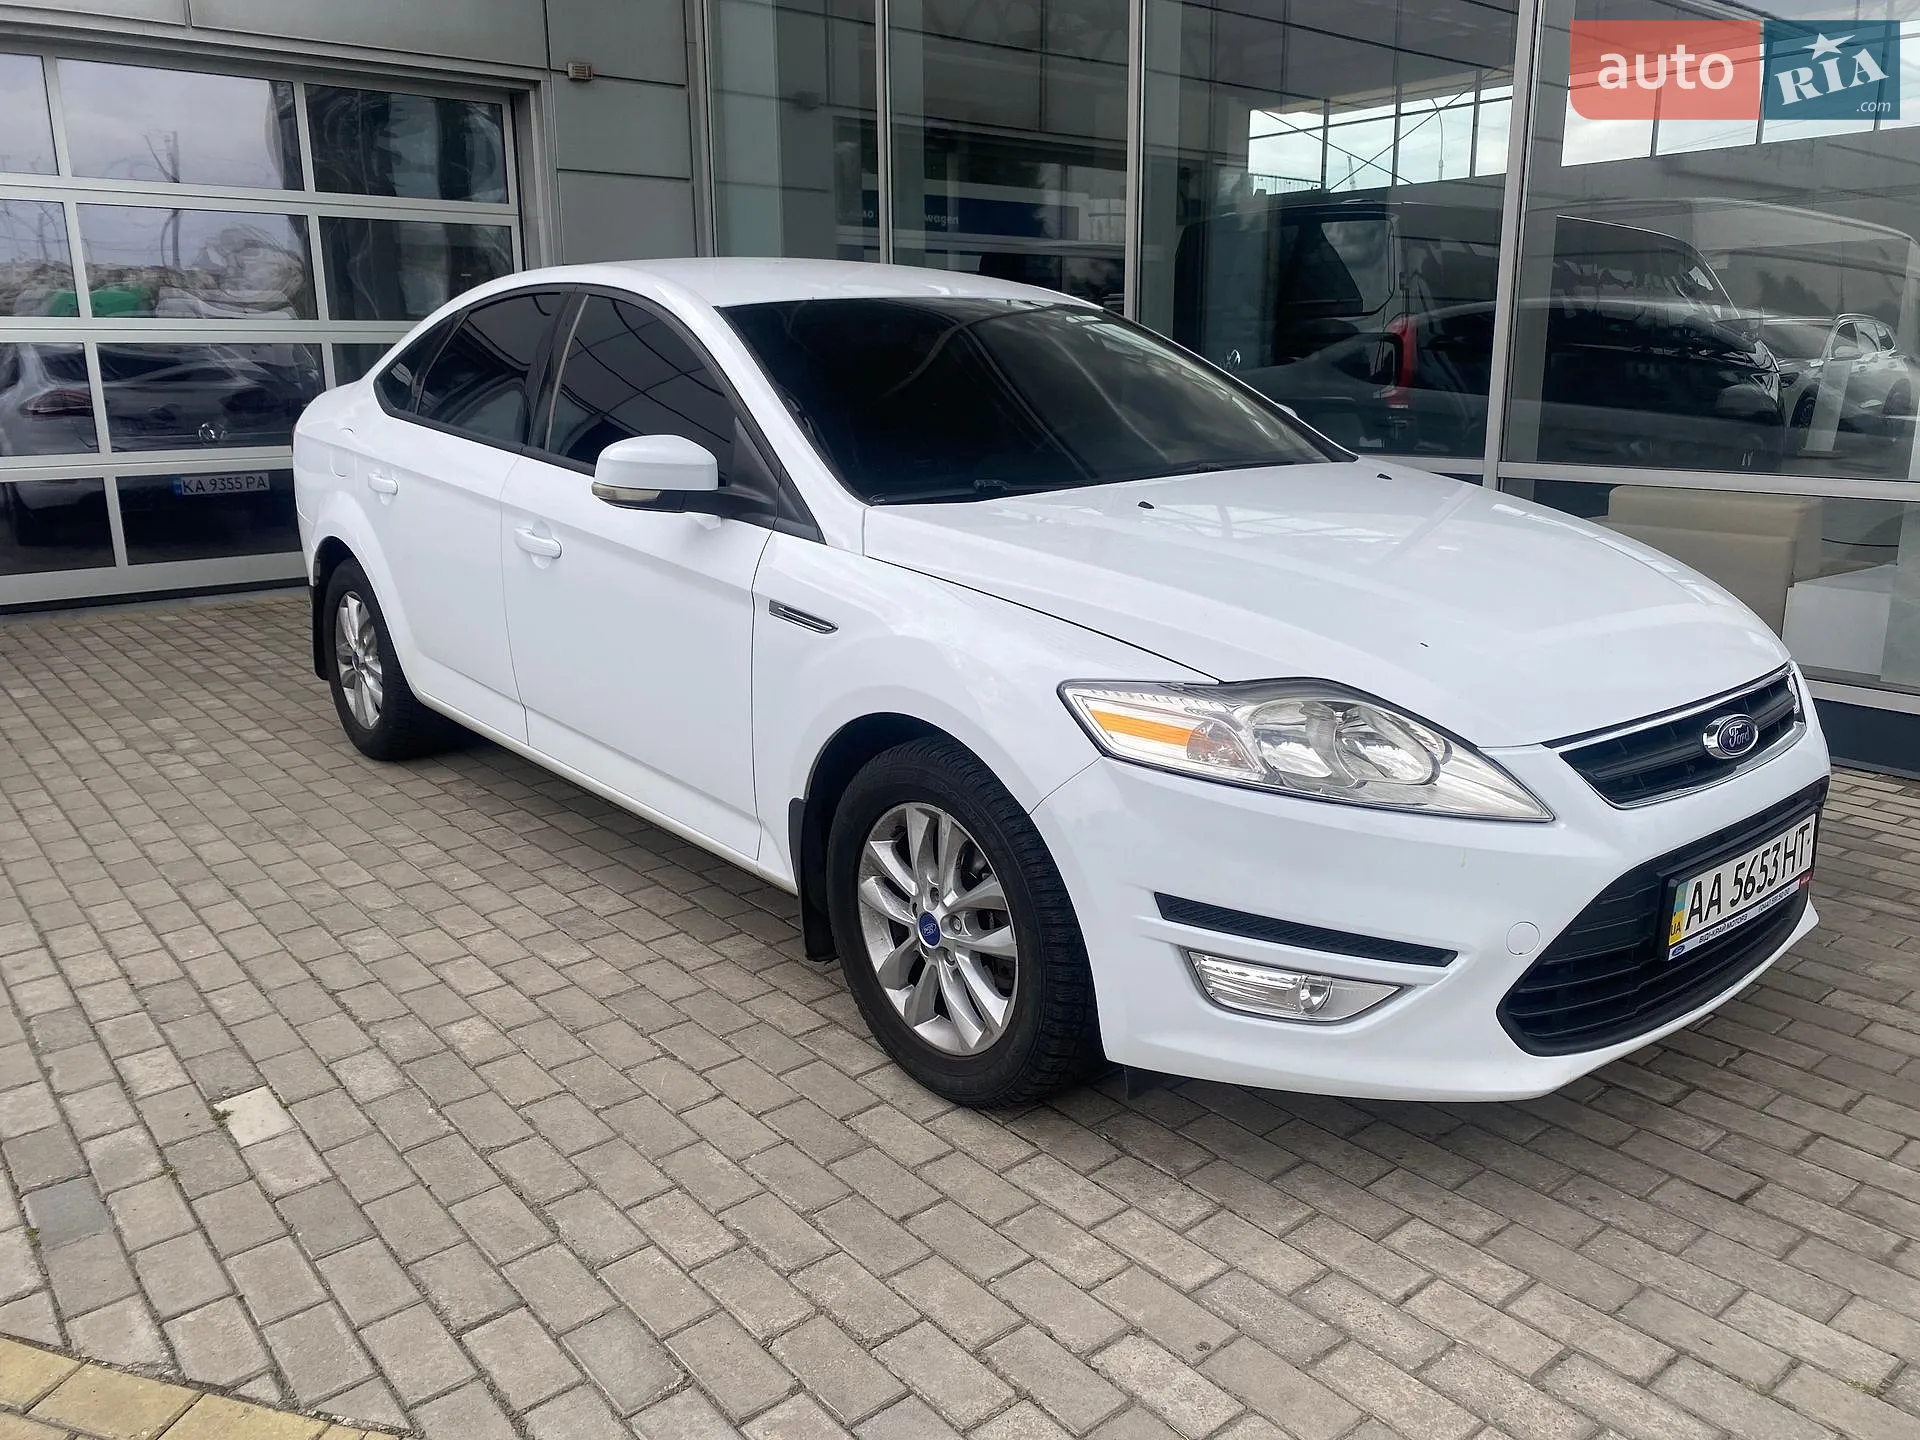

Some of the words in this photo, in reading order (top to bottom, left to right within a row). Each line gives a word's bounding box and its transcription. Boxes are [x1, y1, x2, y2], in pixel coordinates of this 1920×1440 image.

[182, 480, 206, 493] KA
[208, 477, 243, 492] 9355
[245, 475, 266, 489] PA
[1728, 723, 1751, 748] Ford
[1684, 872, 1722, 931] AA
[1729, 841, 1781, 908] 5653
[1781, 822, 1811, 880] HT
[1669, 921, 1682, 937] UA
